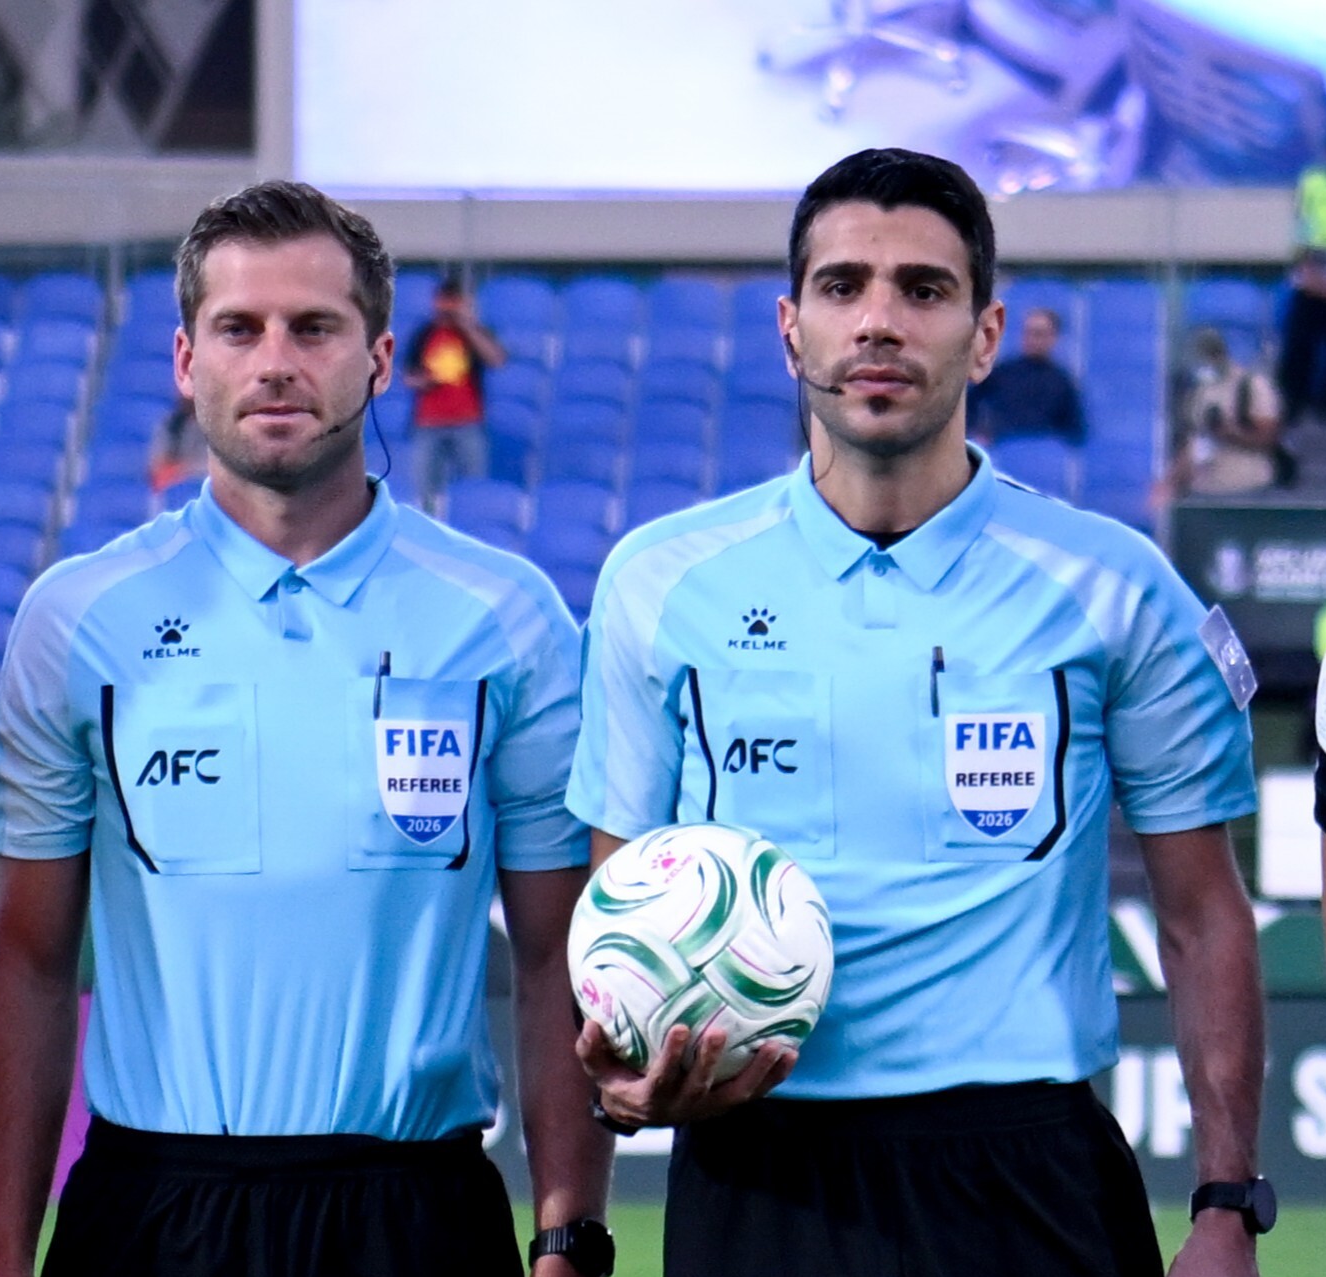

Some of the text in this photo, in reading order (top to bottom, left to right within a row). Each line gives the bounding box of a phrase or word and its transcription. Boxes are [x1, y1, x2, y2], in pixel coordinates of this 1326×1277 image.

[142, 648, 201, 660] KELME
[728, 640, 787, 652] KELME
[386, 729, 462, 758] FIFA
[955, 722, 1036, 751] FIFA
[722, 738, 799, 775] AFC
[135, 749, 221, 787] AFC
[387, 778, 462, 793] REFEREE
[955, 771, 1036, 788] REFEREE
[406, 818, 442, 834] 2026
[976, 812, 1014, 827] 2026
